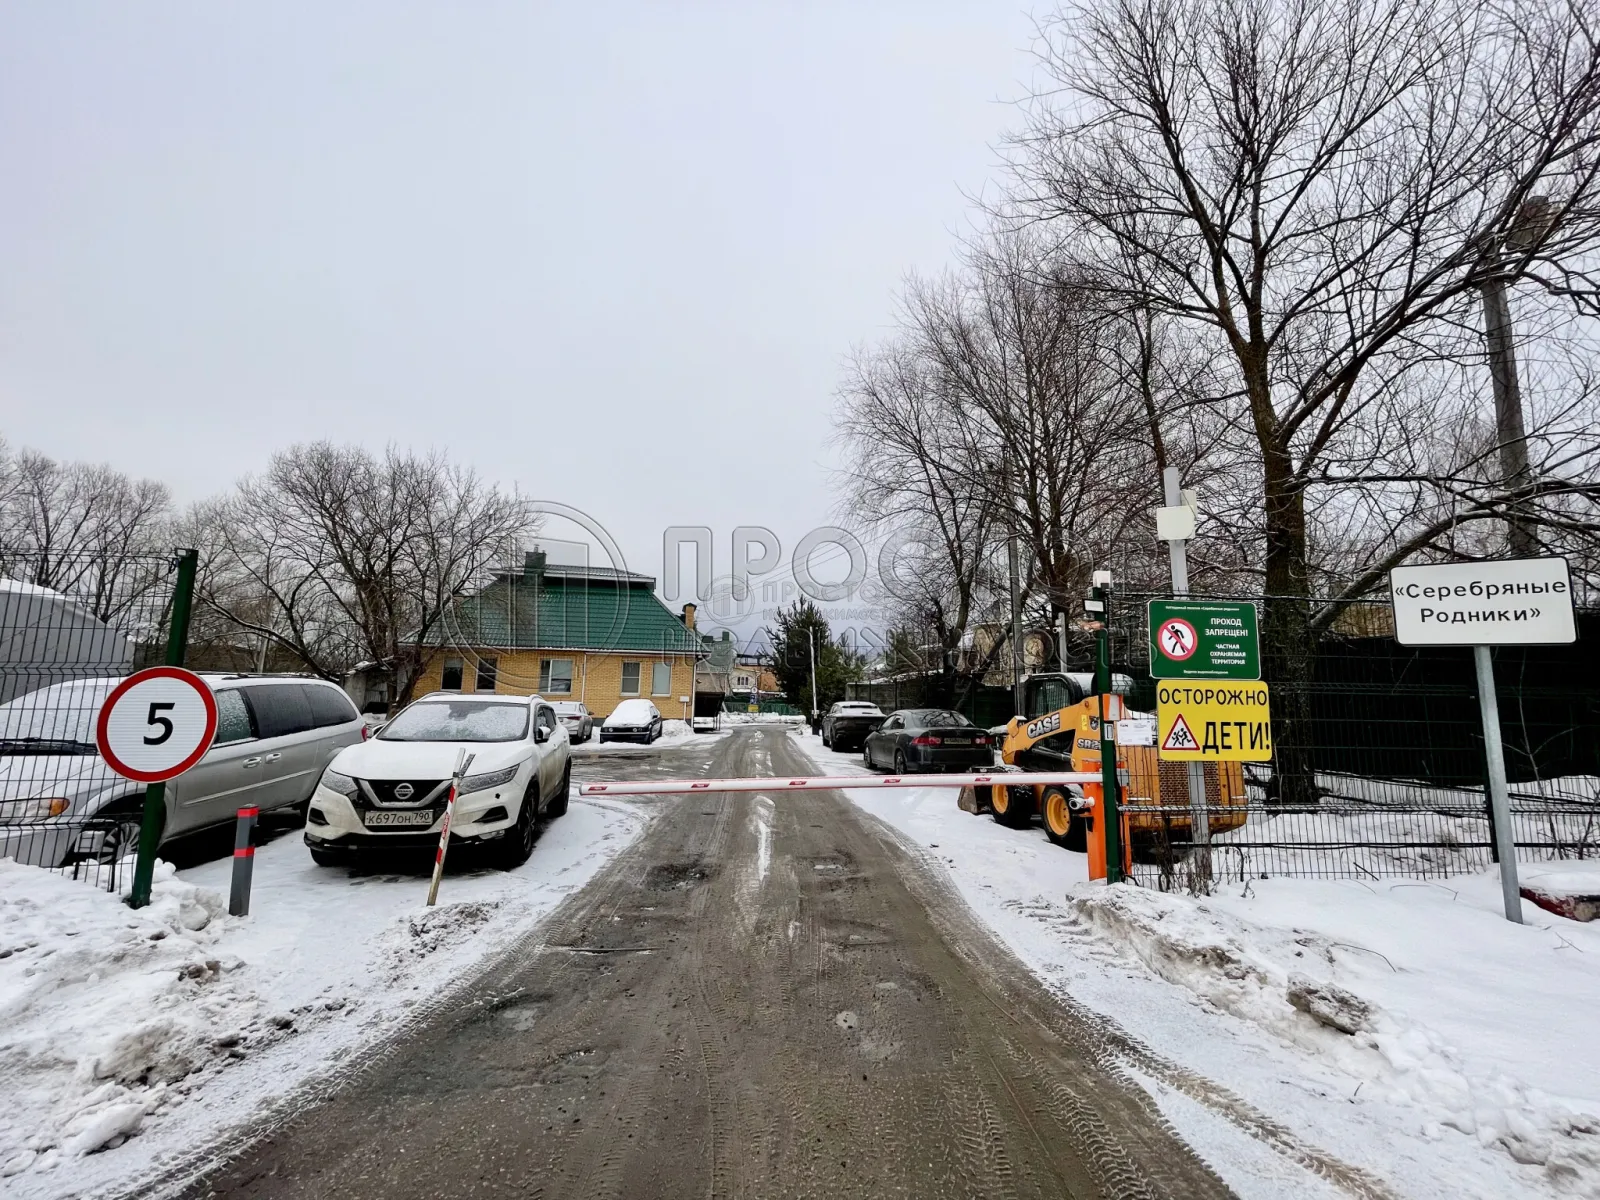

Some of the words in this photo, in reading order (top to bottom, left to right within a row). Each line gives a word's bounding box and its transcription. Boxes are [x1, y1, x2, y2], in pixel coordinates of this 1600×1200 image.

[1394, 581, 1566, 601] «Серебряные
[1210, 618, 1242, 626] ПРОХОД
[1420, 608, 1541, 625] Родники»
[1205, 629, 1249, 637] ЗАПРЕЩЕН!
[1159, 688, 1267, 706] ОСТОРОЖНО
[143, 702, 176, 746] 5
[1027, 712, 1060, 738] CASE
[1202, 722, 1270, 754] ДЕТИ!
[413, 812, 430, 821] 790
